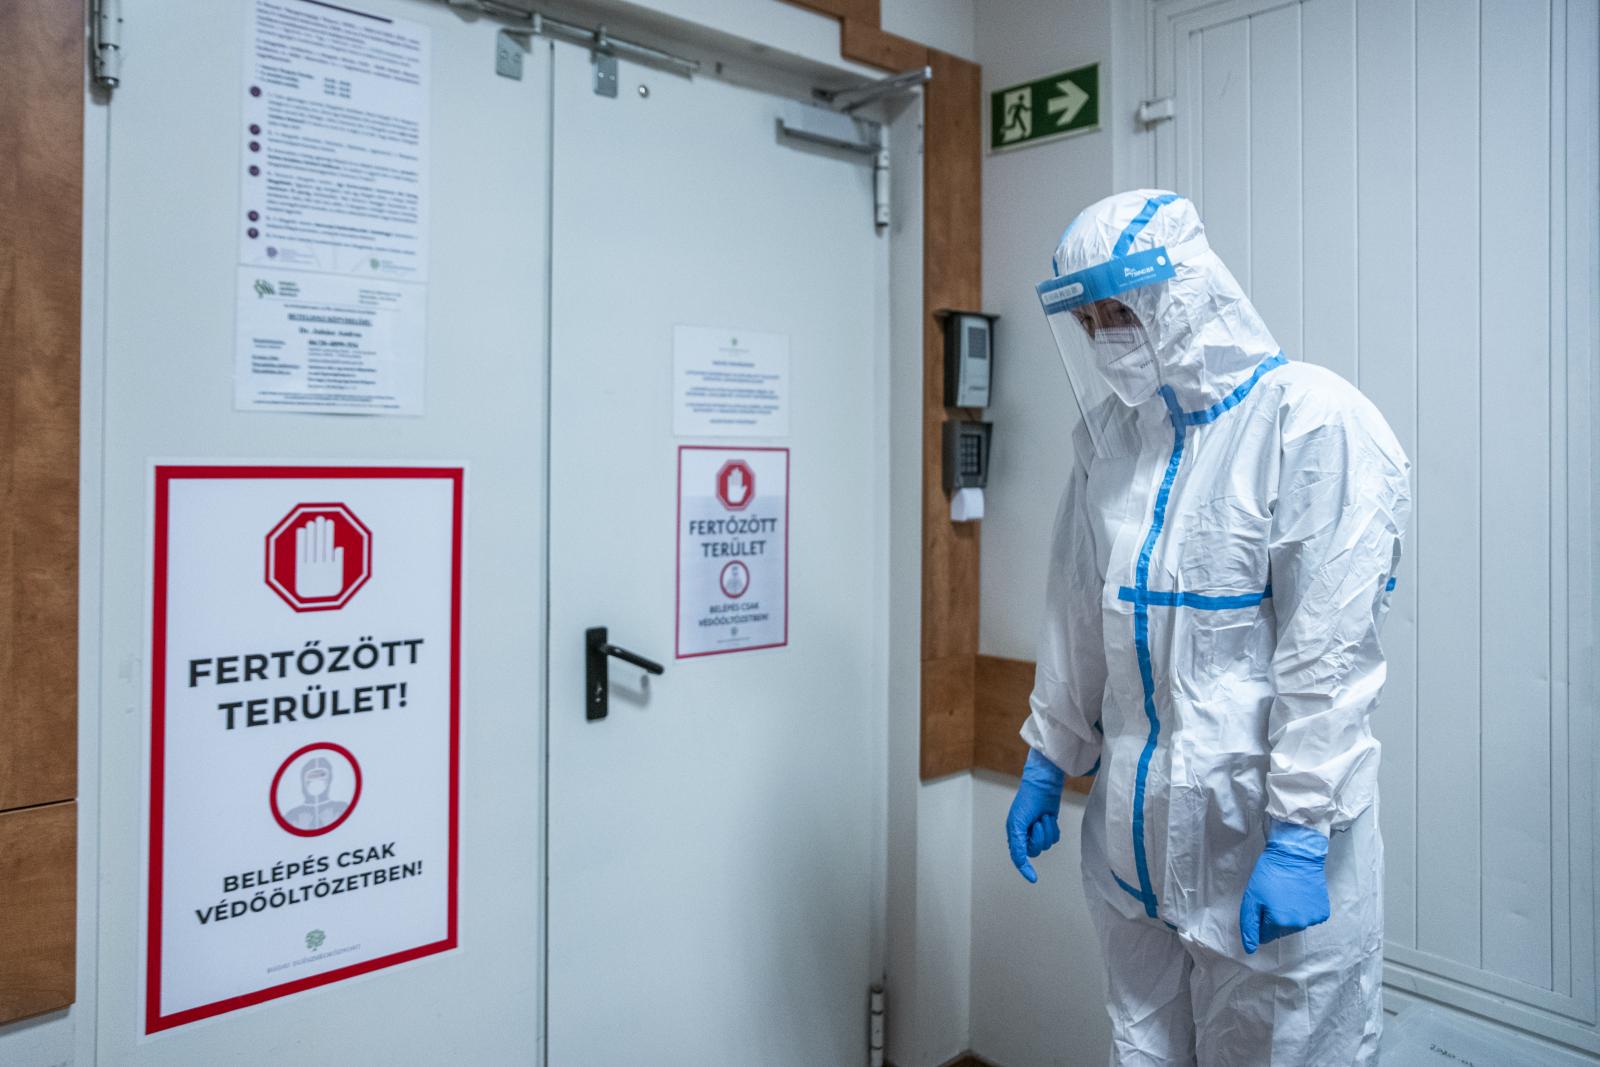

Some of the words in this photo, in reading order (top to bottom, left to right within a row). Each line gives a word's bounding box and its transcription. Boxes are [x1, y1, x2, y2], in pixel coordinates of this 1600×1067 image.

[690, 514, 777, 535] FERTŐZÖTT
[701, 536, 767, 558] TERÜLET
[189, 636, 424, 687] FERTŐZÖTT
[218, 682, 406, 730] TERÜLET!
[224, 856, 329, 893] BELÉPÉS
[337, 842, 395, 867] CSAK
[195, 861, 422, 924] VÉDŐÖLTÖZETBEN!
